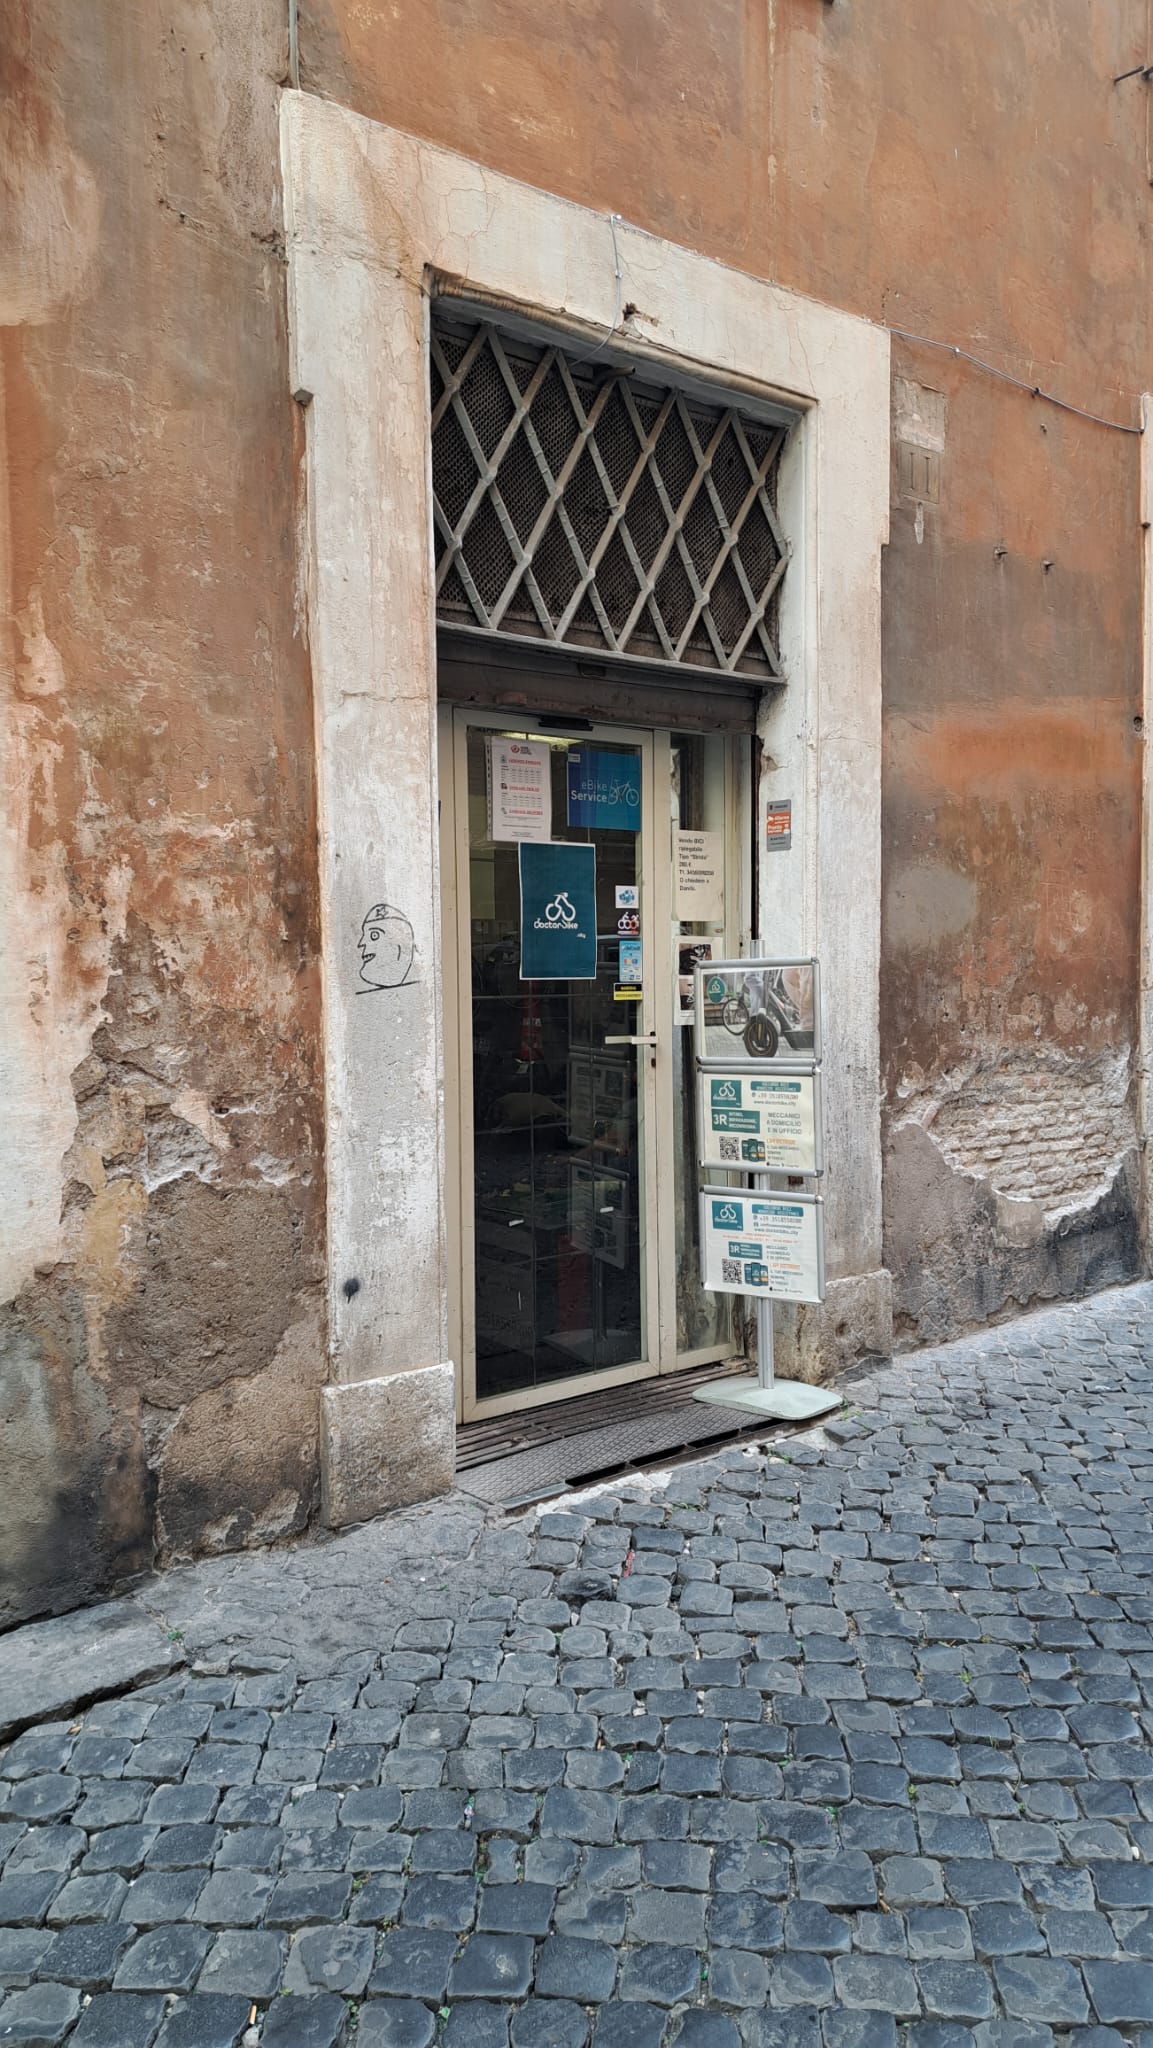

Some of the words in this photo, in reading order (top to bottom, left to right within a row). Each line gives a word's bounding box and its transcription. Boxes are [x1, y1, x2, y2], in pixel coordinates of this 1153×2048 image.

[582, 780, 608, 791] eBike
[571, 790, 608, 803] Service
[534, 918, 579, 929] doctorbike
[713, 1113, 727, 1125] 3R
[730, 1244, 740, 1254] 3R
